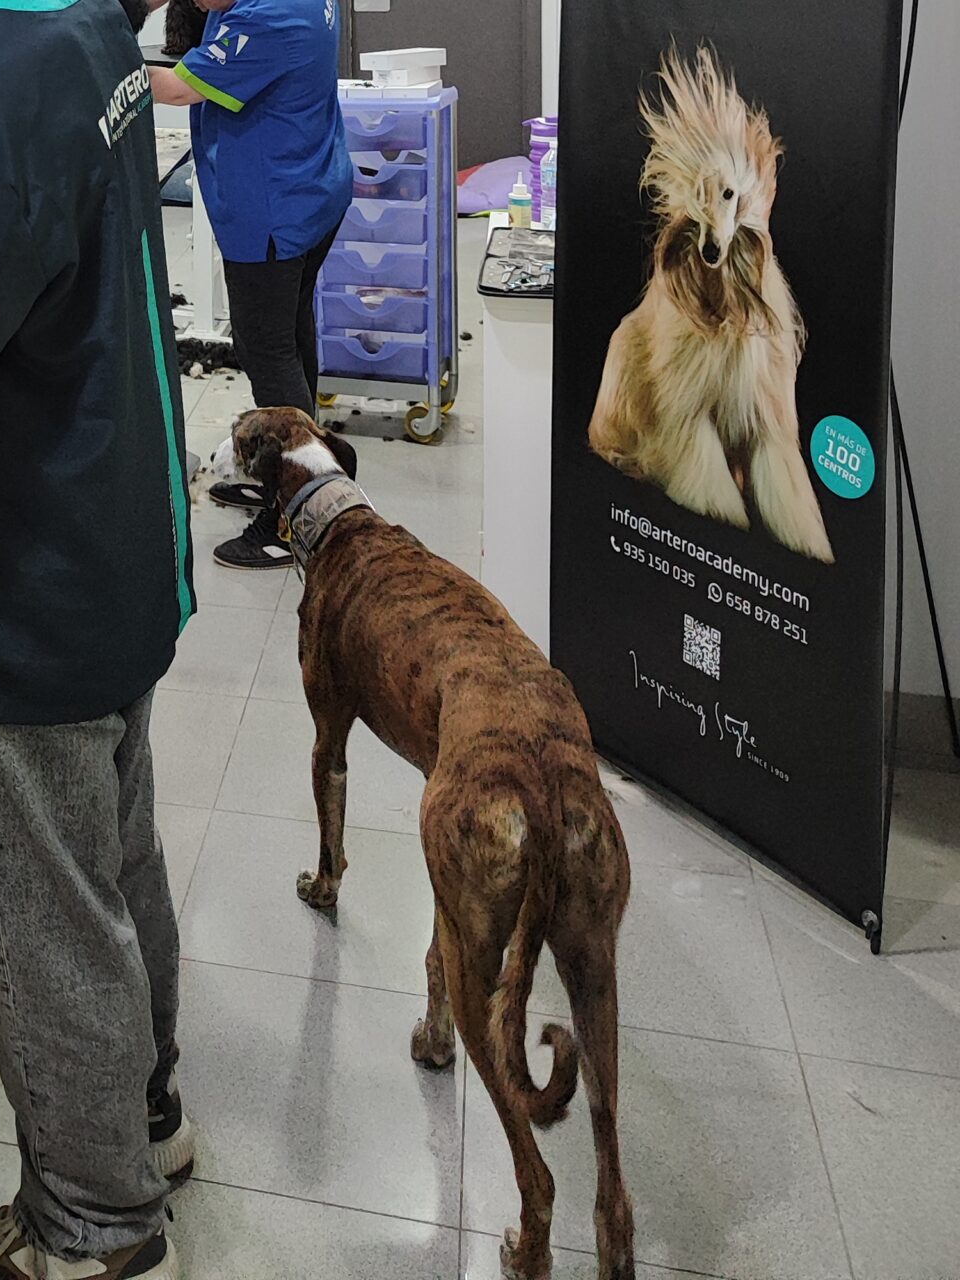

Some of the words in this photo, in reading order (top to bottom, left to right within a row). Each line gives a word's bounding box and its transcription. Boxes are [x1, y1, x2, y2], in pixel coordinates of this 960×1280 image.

[107, 63, 149, 127] ARTERO
[825, 425, 836, 438] EN
[856, 444, 867, 456] DE
[825, 438, 861, 472] 100
[818, 454, 862, 489] CENTROS
[610, 503, 810, 612] info@arteroacademy.com
[623, 541, 646, 563] 935
[648, 553, 670, 575] 150
[672, 566, 695, 588] 035
[726, 592, 751, 615] 658
[754, 606, 780, 630] 878
[783, 619, 808, 645] 251
[629, 650, 706, 736] Inspiring
[715, 702, 757, 758] Style
[747, 751, 768, 770] SINCE
